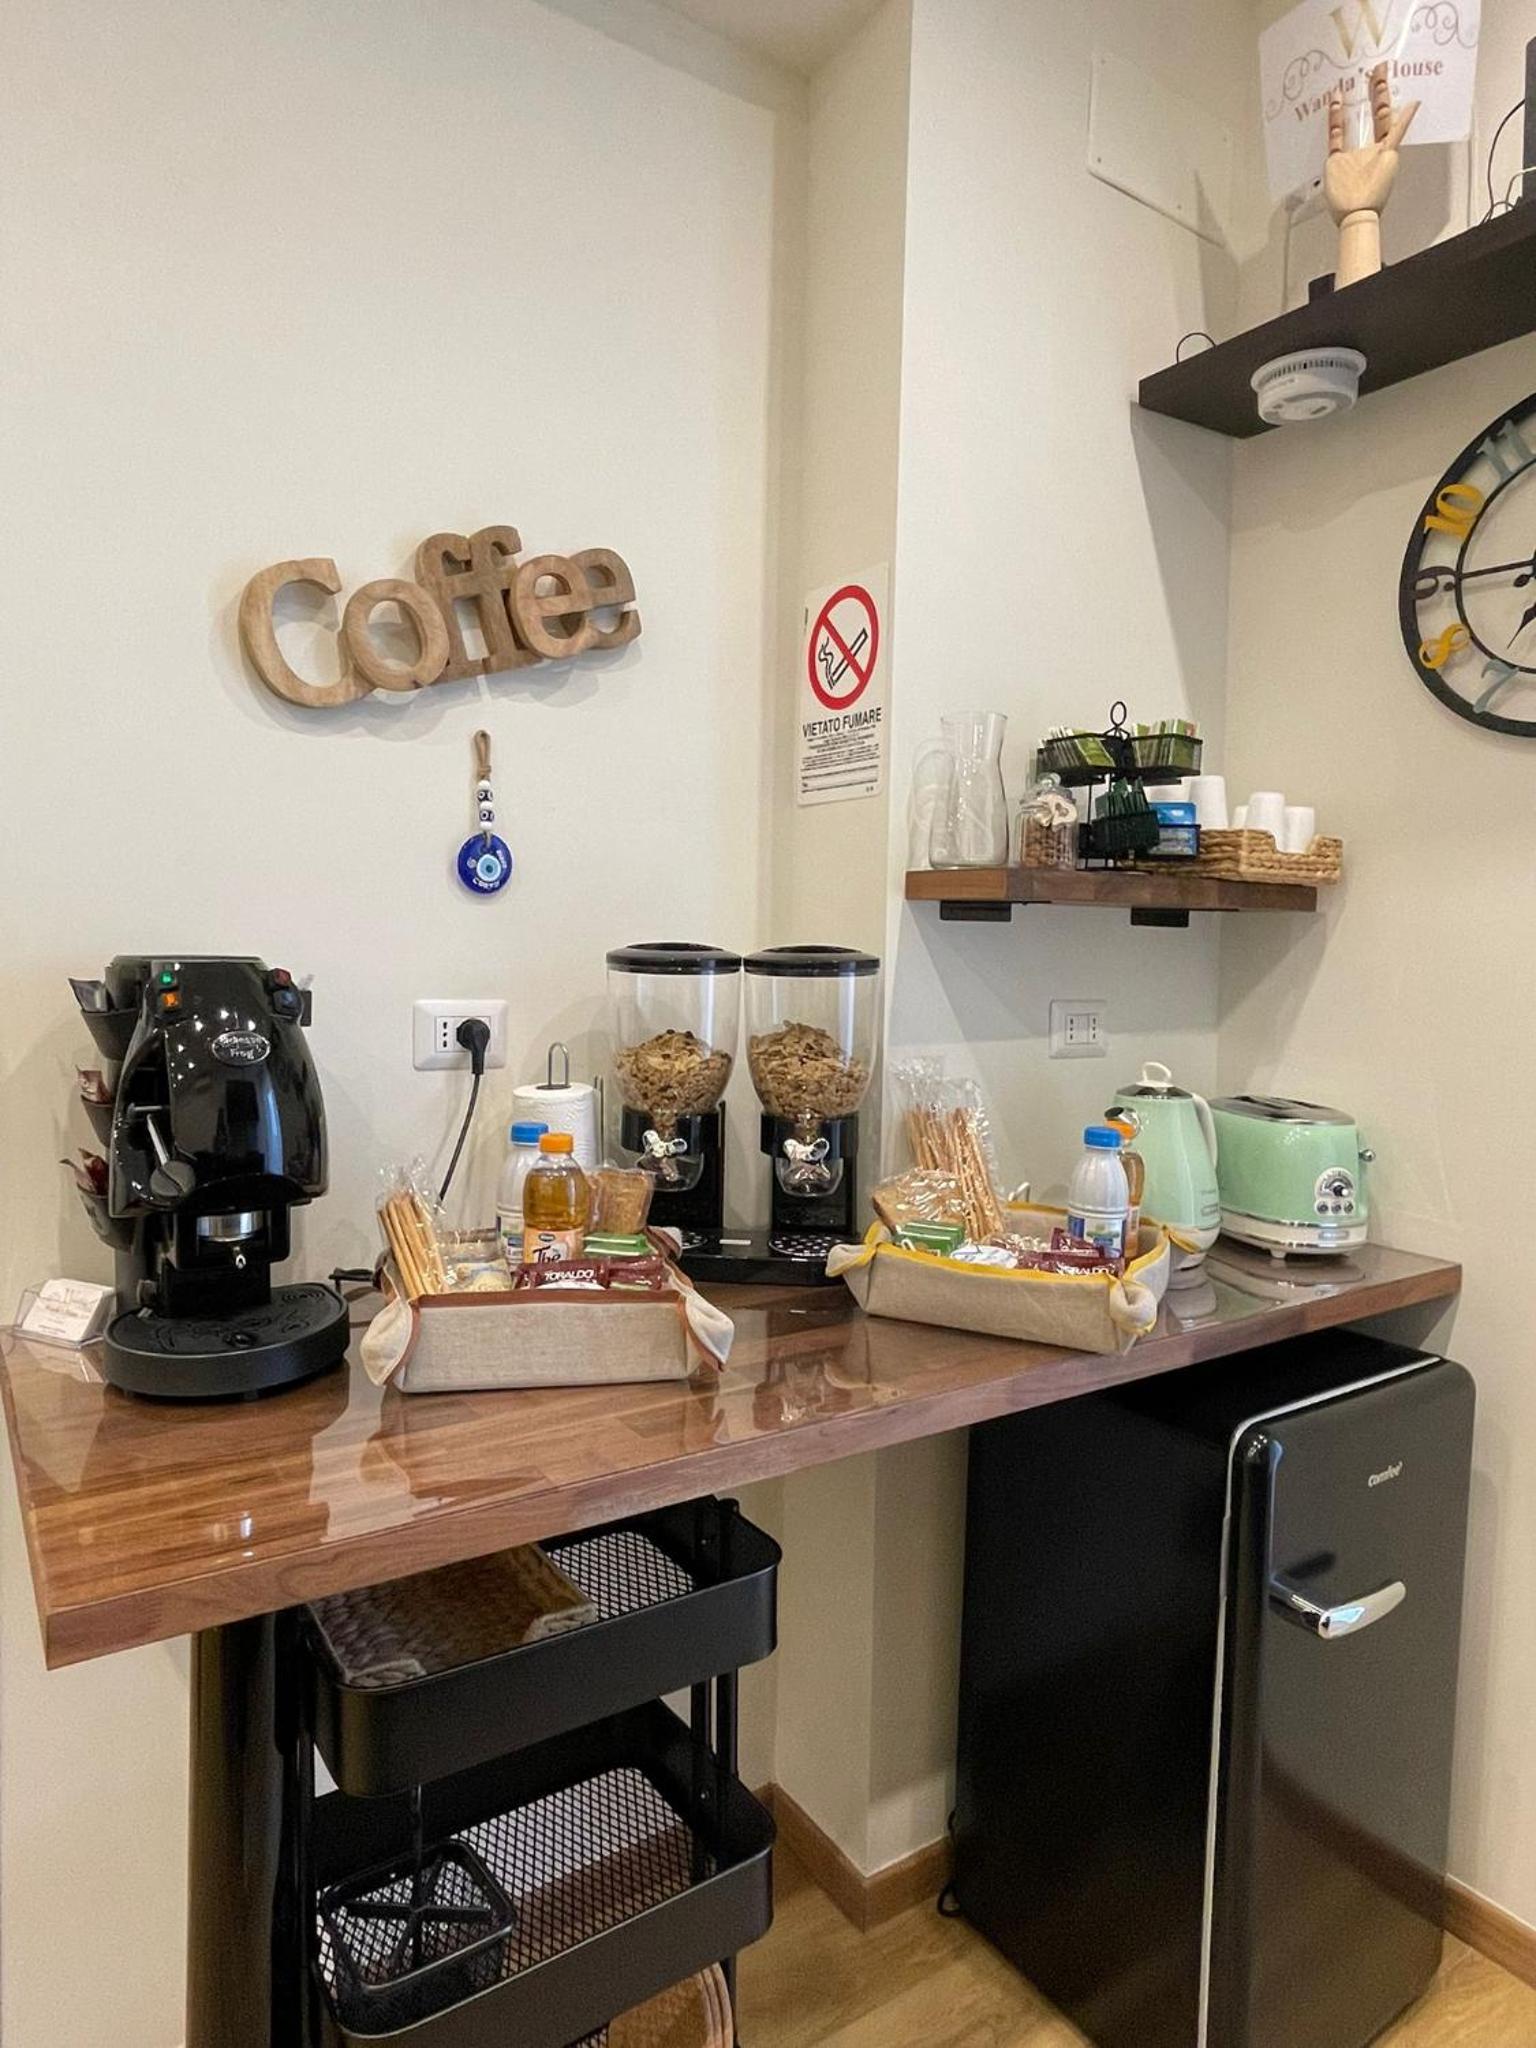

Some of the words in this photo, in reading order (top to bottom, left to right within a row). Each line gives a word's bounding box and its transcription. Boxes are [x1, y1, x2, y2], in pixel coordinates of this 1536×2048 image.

[1423, 484, 1484, 540] 10
[238, 524, 642, 709] Coffee
[1419, 623, 1470, 670] 8
[1472, 658, 1520, 714] 7
[802, 717, 841, 738] VIETATO
[842, 707, 882, 729] FUMARE
